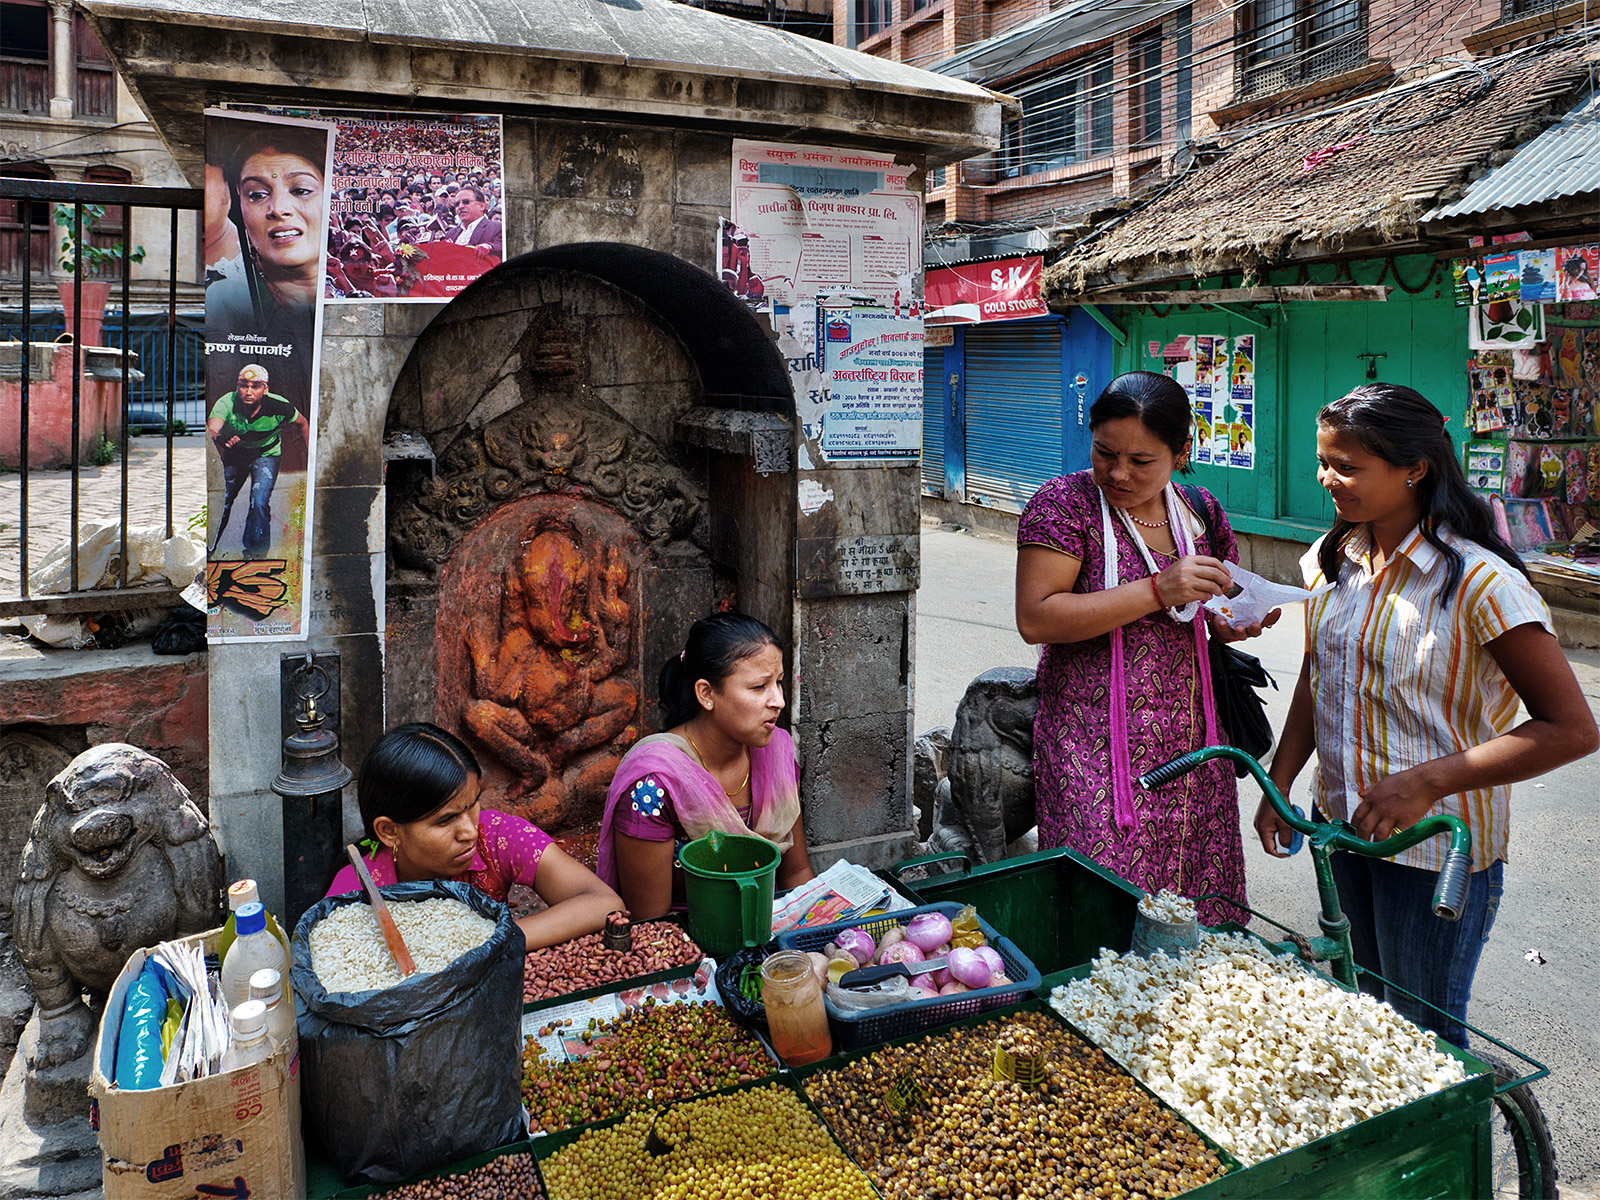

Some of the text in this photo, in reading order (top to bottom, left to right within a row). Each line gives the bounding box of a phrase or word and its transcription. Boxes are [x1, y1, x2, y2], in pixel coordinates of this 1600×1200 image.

[766, 149, 895, 169] संयुक्त धर्मका आयोजनाम
[758, 200, 788, 216] प्राचीन
[837, 201, 866, 216] भण्डार
[991, 266, 1023, 291] S.K
[983, 297, 1040, 314] COLD STORE
[890, 368, 916, 382] विराट
[1077, 394, 1085, 426] PEPSI
[235, 1103, 263, 1121] CG
